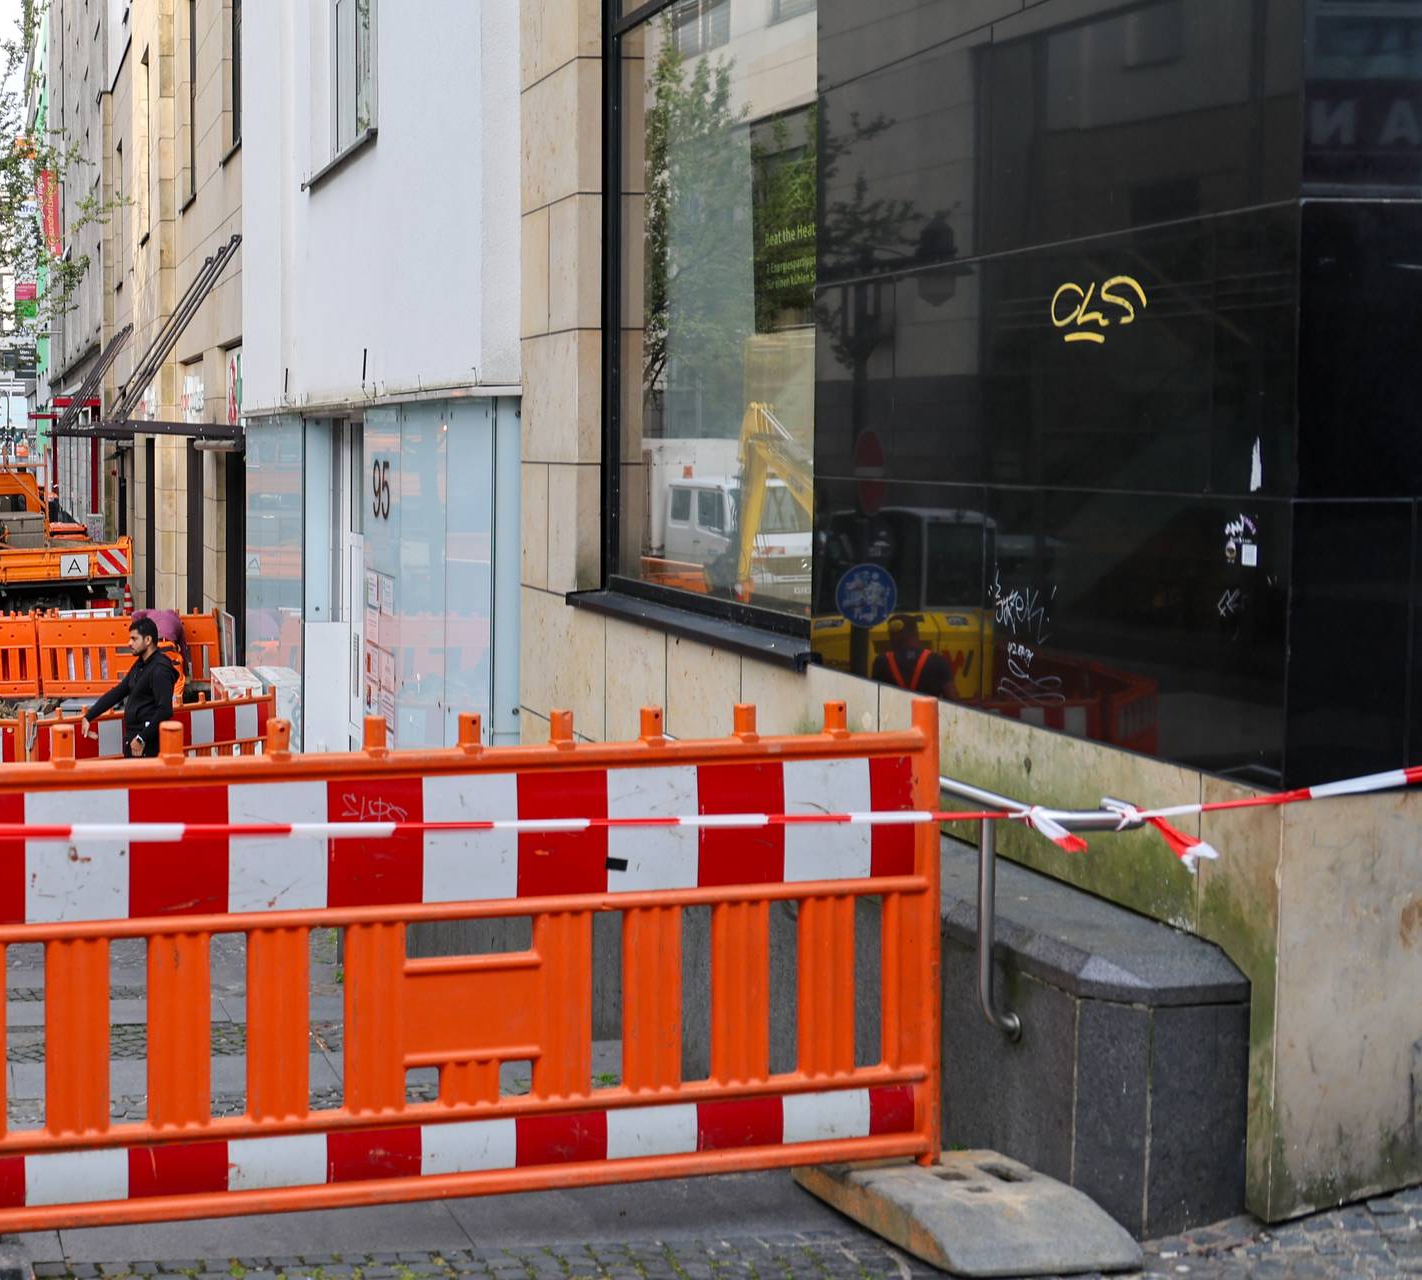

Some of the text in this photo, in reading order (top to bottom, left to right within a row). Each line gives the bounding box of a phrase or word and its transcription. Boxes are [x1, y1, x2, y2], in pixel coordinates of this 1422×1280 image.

[764, 222, 816, 249] Beat the Heat
[373, 459, 390, 520] 95
[68, 558, 81, 573] A
